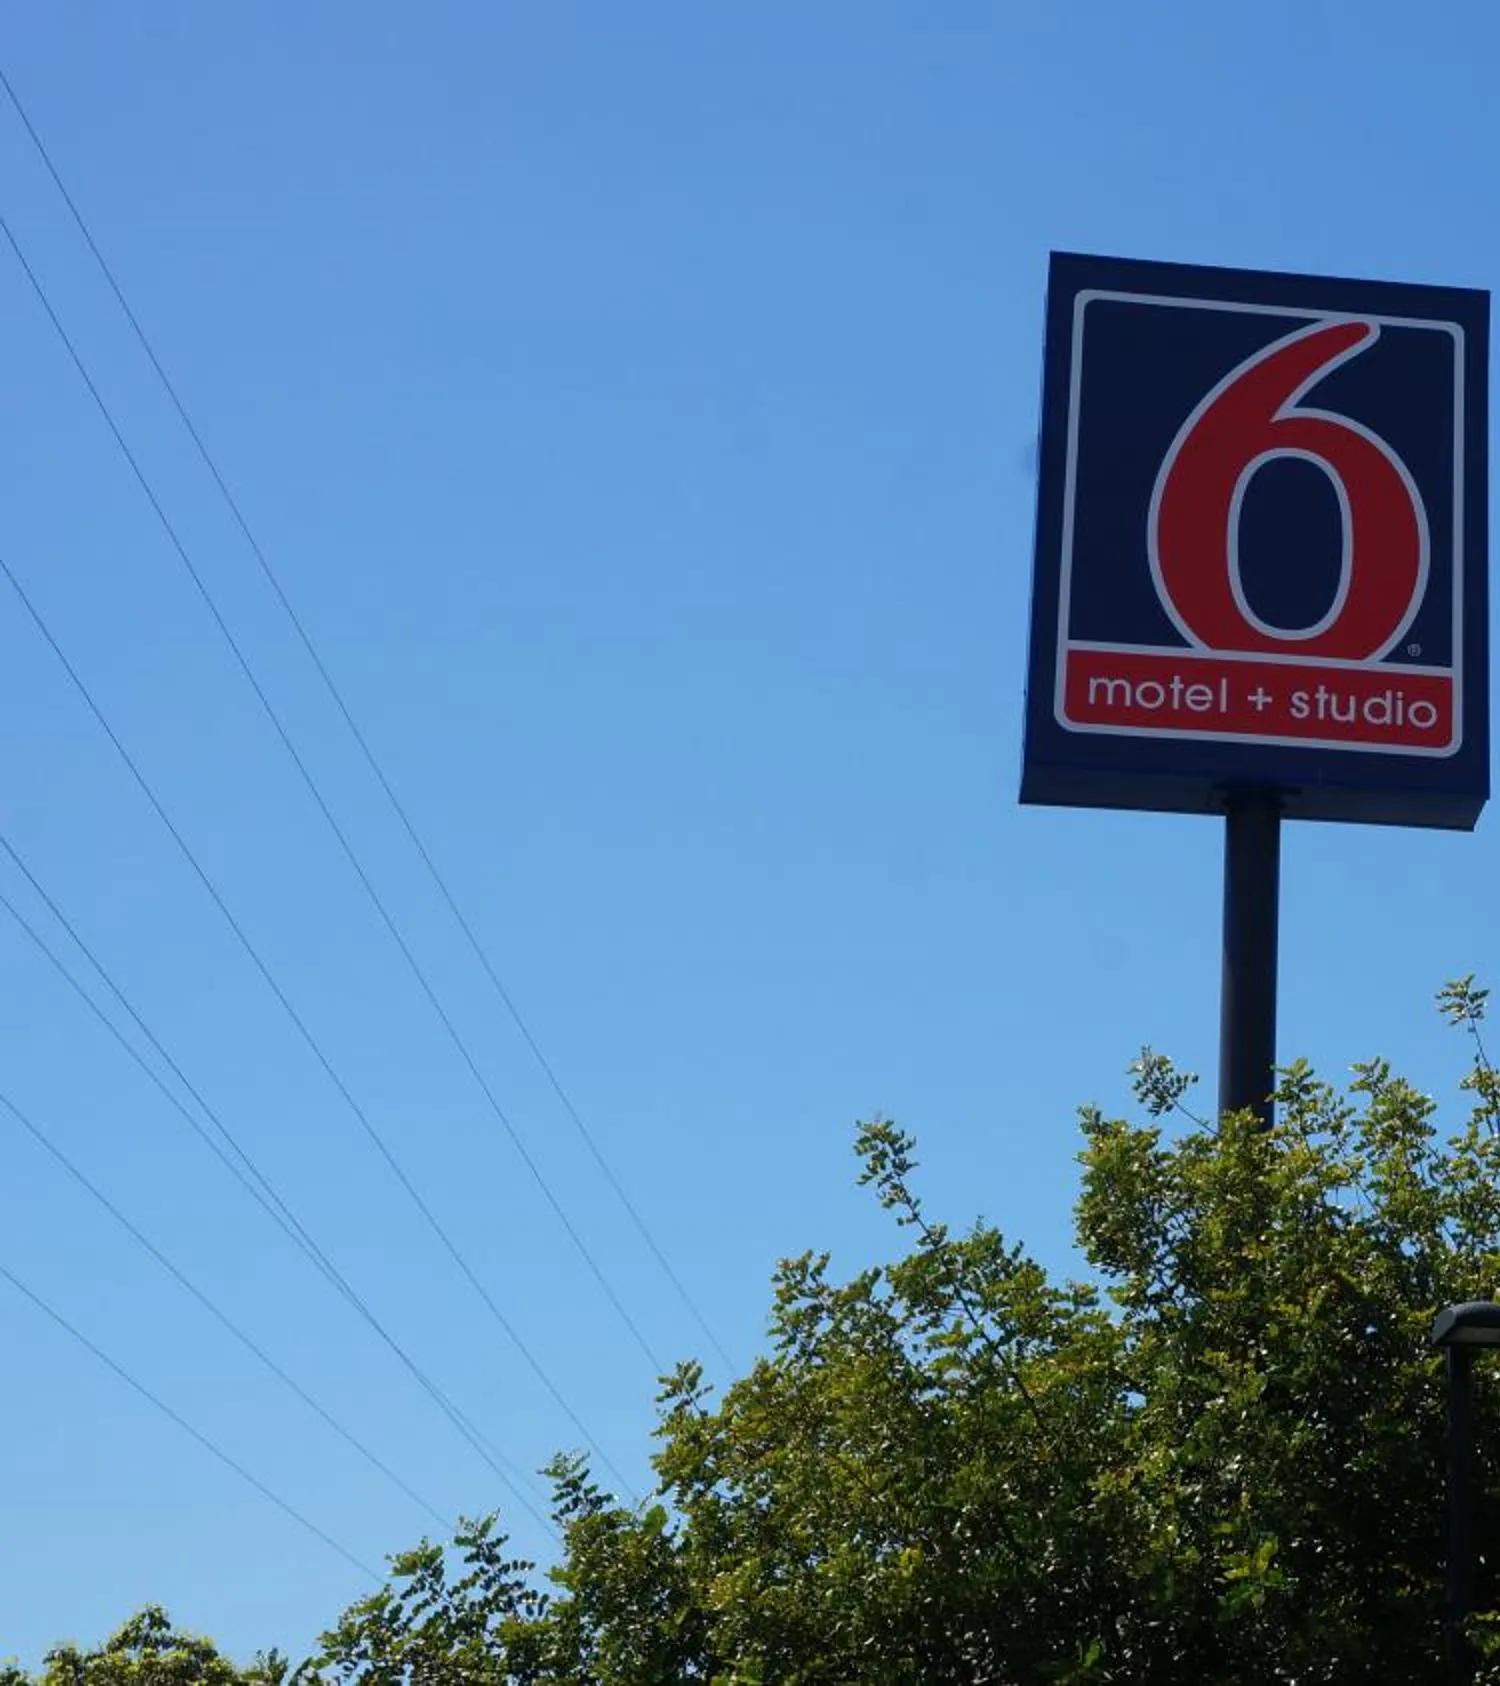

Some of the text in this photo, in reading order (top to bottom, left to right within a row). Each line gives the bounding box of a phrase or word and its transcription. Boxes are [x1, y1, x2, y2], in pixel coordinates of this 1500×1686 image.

[1148, 317, 1431, 664] 6
[1088, 675, 1228, 713] motel
[1289, 685, 1438, 729] studio
